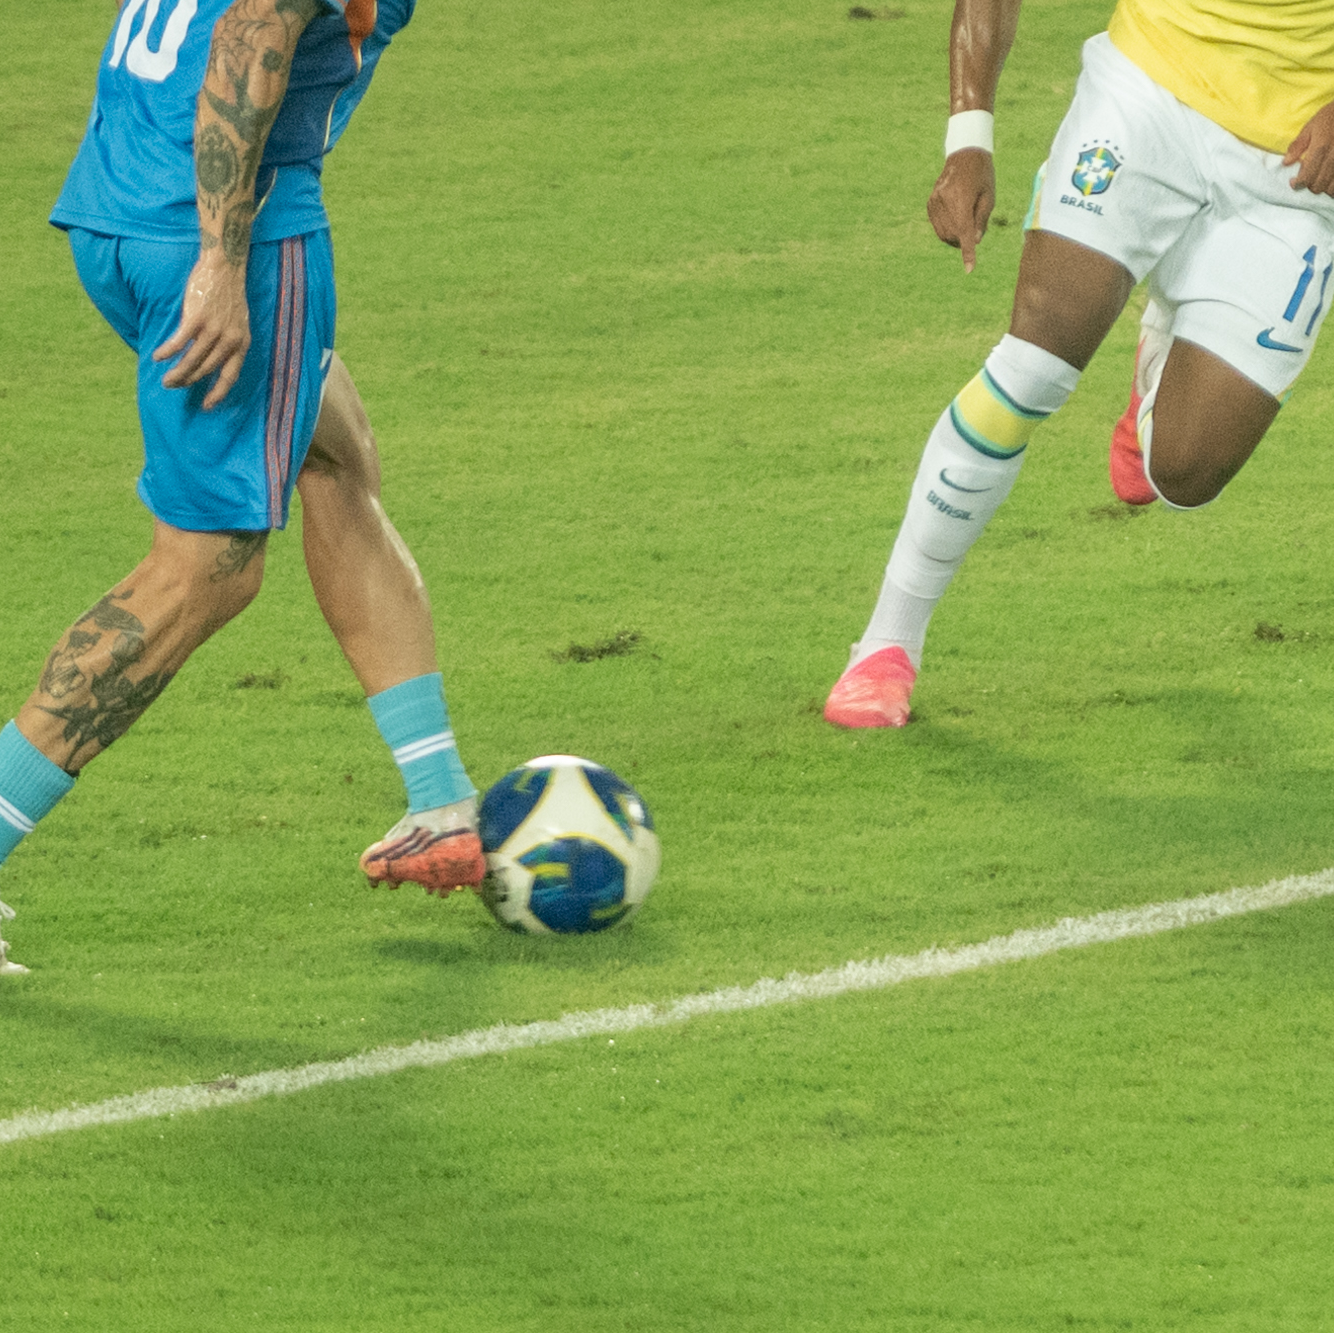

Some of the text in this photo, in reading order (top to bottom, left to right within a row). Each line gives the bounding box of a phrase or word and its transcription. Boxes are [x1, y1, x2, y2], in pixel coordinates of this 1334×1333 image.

[1060, 194, 1104, 216] BRASIL
[1283, 244, 1334, 337] 11
[926, 489, 974, 520] BRASIL
